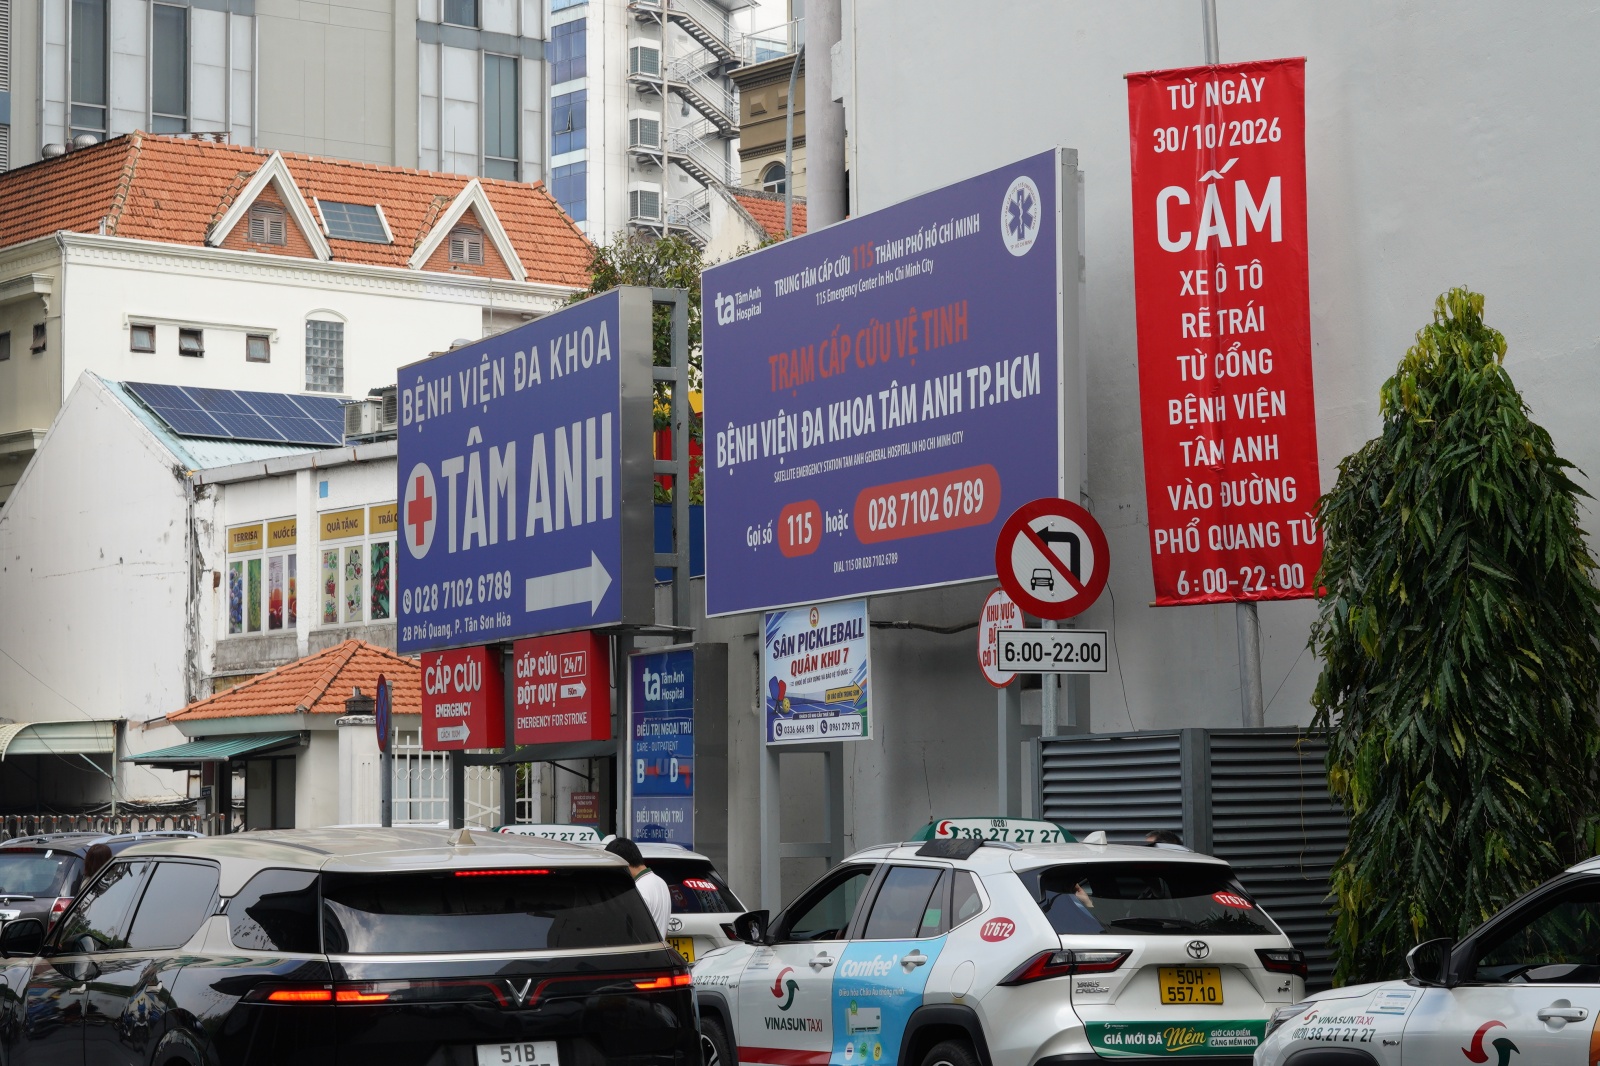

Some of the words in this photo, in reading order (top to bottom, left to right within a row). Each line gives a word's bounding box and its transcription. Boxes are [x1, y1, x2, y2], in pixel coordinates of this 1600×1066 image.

[1167, 78, 1197, 110] TỪ
[1205, 73, 1265, 107] NGÀY
[1153, 117, 1282, 153] 30/10/2026
[1155, 158, 1282, 253] CẤM
[774, 272, 800, 298] TRUNG
[801, 265, 817, 292] TÂM
[818, 257, 833, 285] CẤP
[834, 253, 851, 281] CỨU
[852, 241, 874, 272] 115
[875, 239, 905, 266] THÀNH
[905, 226, 923, 256] PHỐ
[924, 222, 938, 249] HỒ
[939, 219, 954, 246] CHÍ
[955, 213, 980, 240] MINH
[815, 291, 827, 306] 115
[827, 283, 858, 306] Emergency
[858, 277, 877, 295] Center
[878, 275, 884, 290] In
[885, 272, 894, 287] Ho
[894, 268, 904, 283] Chi
[904, 263, 921, 281] Minh
[921, 259, 934, 277] City
[1179, 270, 1209, 296] XE
[1215, 262, 1227, 293] Ô
[1235, 258, 1263, 291] TÔ
[735, 289, 748, 306] Tâm
[748, 286, 761, 302] Anh
[736, 304, 762, 322] Hospital
[1182, 306, 1211, 338] RẼ
[1217, 300, 1265, 336] TRÁI
[768, 344, 815, 397] TRẠM
[818, 324, 851, 377] CẤP
[855, 318, 892, 369] CỨU
[894, 306, 919, 367] VỆ
[922, 300, 968, 350] TINH
[1176, 348, 1208, 381] TỪ
[1214, 342, 1273, 379] CỔNG
[403, 375, 452, 432] BỆNH
[459, 354, 505, 413] VIỆN
[513, 346, 542, 392] ĐA
[550, 320, 611, 380] KHOA
[716, 422, 758, 476] BỆNH
[761, 409, 798, 465] VIỆN
[801, 407, 824, 448] ĐA
[828, 395, 876, 443] KHOA
[879, 380, 918, 431] TÂM
[922, 371, 962, 420] ANH
[966, 352, 1041, 410] TP.HCM
[1168, 392, 1226, 430] BỆNH
[1233, 386, 1286, 424] VIỆN
[774, 464, 796, 483] SATELLITE
[796, 458, 823, 479] EMERGENCY
[823, 454, 843, 474] STATION
[843, 453, 853, 469] TAM
[854, 451, 864, 467] ANH
[864, 445, 887, 465] GENERAL
[887, 440, 911, 462] HOSPITAL
[912, 440, 918, 454] IN
[918, 438, 926, 453] HO
[926, 436, 936, 452] CHI
[936, 433, 951, 449] MINH
[951, 430, 964, 446] CITY
[1179, 435, 1225, 467] TÂM
[1232, 434, 1279, 464] ANH
[442, 426, 516, 554] TÂM
[526, 412, 612, 538] ANH
[1167, 477, 1212, 511] VÀO
[1220, 472, 1297, 508] ĐƯỜNG
[326, 519, 340, 532] QUÀ
[341, 517, 359, 532] TẶNG
[378, 514, 393, 525] TRÁI
[746, 525, 762, 551] Gọi
[762, 520, 773, 544] số
[787, 511, 813, 546] 115
[825, 510, 849, 537] hoặc
[868, 498, 897, 532] 028
[900, 489, 939, 527] 7102
[942, 477, 984, 518] 6789
[234, 530, 258, 542] TERRISA
[273, 528, 290, 540] NƯỚC
[1154, 517, 1200, 555] PHỔ
[1208, 521, 1280, 550] QUANG
[414, 582, 438, 614] 028
[442, 576, 474, 608] 7102
[478, 570, 512, 602] 6789
[1177, 563, 1305, 596] 6:00-22:00
[402, 627, 412, 642] 2B
[413, 621, 427, 640] Phổ
[426, 622, 453, 642] Quang,
[454, 621, 463, 634] P.
[464, 616, 478, 633] Tân
[479, 614, 495, 631] Sơn
[496, 612, 512, 628] Hòa
[986, 604, 999, 622] KHU
[1000, 602, 1014, 624] VỰC
[772, 634, 795, 660] SÂN
[798, 618, 864, 653] PICKLEBALL
[1004, 642, 1101, 663] 6:00-22:00
[516, 651, 536, 678] CẤP
[538, 650, 558, 676] CỨU
[564, 656, 582, 674] 24/7
[790, 654, 818, 677] QUÂN
[820, 651, 840, 669] KHU
[843, 647, 850, 664] 7
[983, 646, 992, 667] CÓ
[425, 655, 452, 696] CẤP
[454, 654, 482, 692] CỨU
[661, 672, 673, 684] Tâm
[673, 670, 684, 684] Anh
[517, 681, 536, 710] ĐỘT
[538, 682, 558, 708] QUỴ
[662, 687, 684, 702] Hospital
[436, 702, 472, 718] EMERGENCY
[518, 715, 551, 729] EMERGENCY
[552, 713, 564, 727] FOR
[564, 712, 588, 726] STROKE
[680, 718, 692, 734] TRÚ
[991, 820, 1007, 828] (028)
[1014, 829, 1034, 843] 27
[1040, 830, 1060, 843] 27
[1215, 894, 1251, 908] 17672
[983, 922, 1013, 937] 17672
[1177, 970, 1204, 985] 50H
[1168, 987, 1216, 1002] 557.10
[1104, 1032, 1123, 1045] GIÁ
[1125, 1031, 1146, 1045] MỚI
[1148, 1031, 1163, 1045] ĐÃ
[1163, 1027, 1206, 1046] Mềm
[1211, 1037, 1228, 1046] CÀNG
[1243, 1038, 1257, 1046] HƠN
[1235, 1027, 1250, 1037] ĐIỂM
[1342, 1028, 1358, 1042] 27
[1360, 1028, 1376, 1042] 27
[500, 1044, 535, 1063] 51B
